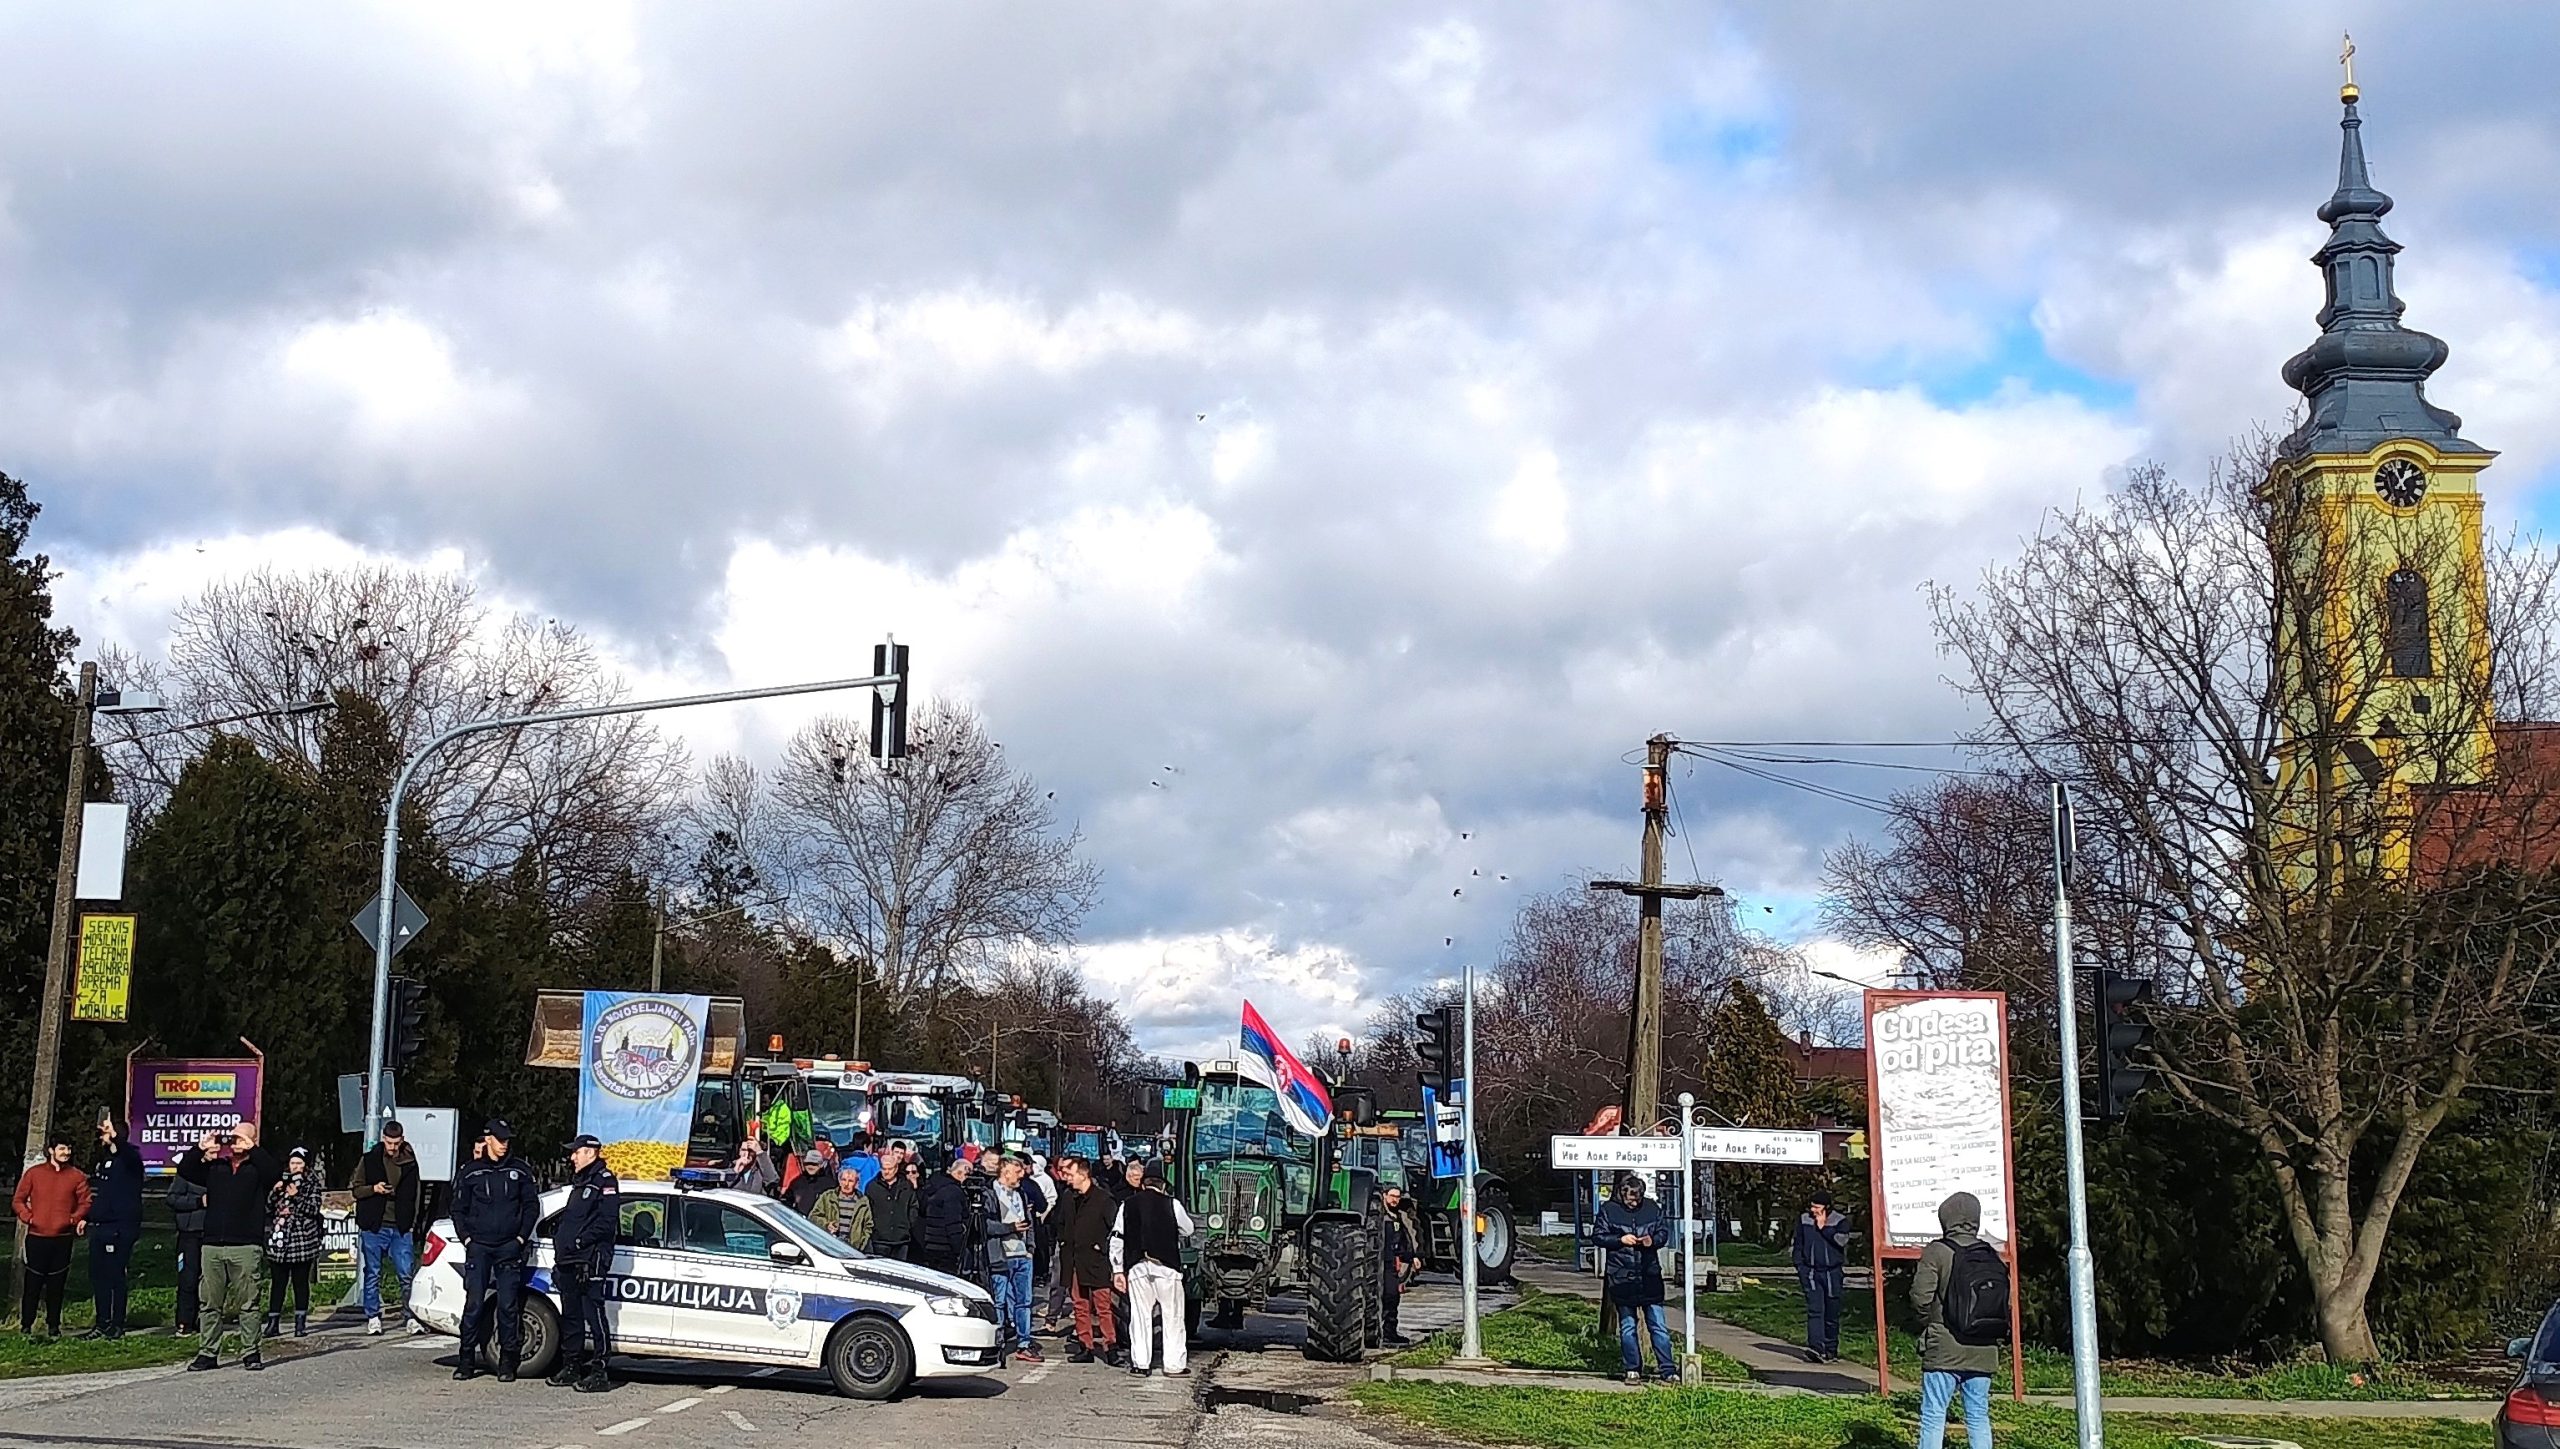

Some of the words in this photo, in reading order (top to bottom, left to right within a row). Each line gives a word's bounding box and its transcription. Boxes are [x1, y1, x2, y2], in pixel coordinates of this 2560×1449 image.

[89, 921, 129, 933] SERVIS
[83, 947, 128, 961] TELEFONA
[80, 1004, 123, 1020] MOBILNE
[1882, 1043, 1920, 1074] od
[1924, 1035, 1997, 1075] pita
[160, 1080, 232, 1092] TRGOBAN
[640, 1085, 670, 1098] Novo
[146, 1114, 193, 1126] VELIKI
[197, 1114, 242, 1126] IZBOR
[142, 1130, 178, 1142] BELE
[1702, 1142, 1717, 1152] Иве
[1755, 1144, 1787, 1156] Рибара
[1562, 1151, 1579, 1160] Иве
[1616, 1151, 1648, 1163] Рибара
[604, 1278, 757, 1310] ПОЛИЦИЈА
